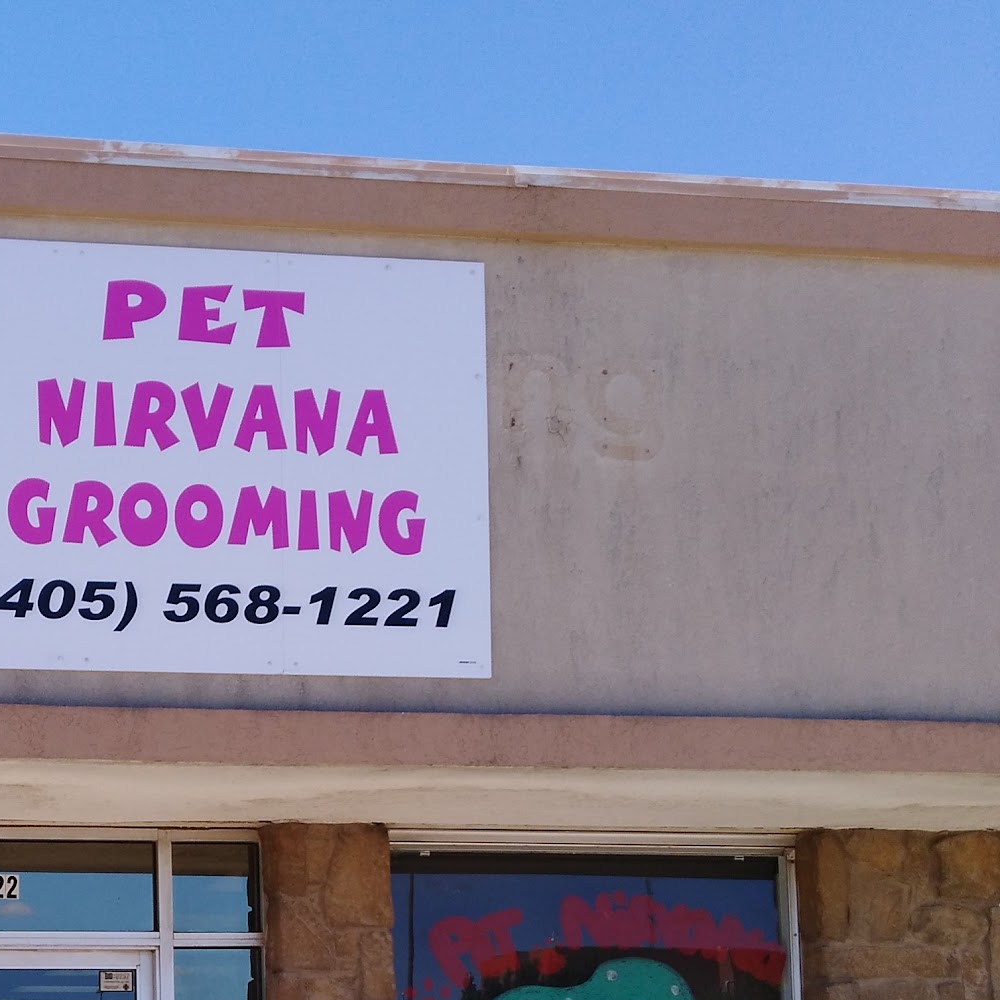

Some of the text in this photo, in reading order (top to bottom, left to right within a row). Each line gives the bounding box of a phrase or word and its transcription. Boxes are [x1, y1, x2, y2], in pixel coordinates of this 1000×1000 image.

[103, 279, 306, 349] PET
[37, 377, 399, 457] NIRVANA
[7, 477, 426, 556] GROOMING
[162, 583, 457, 629] 568-1221
